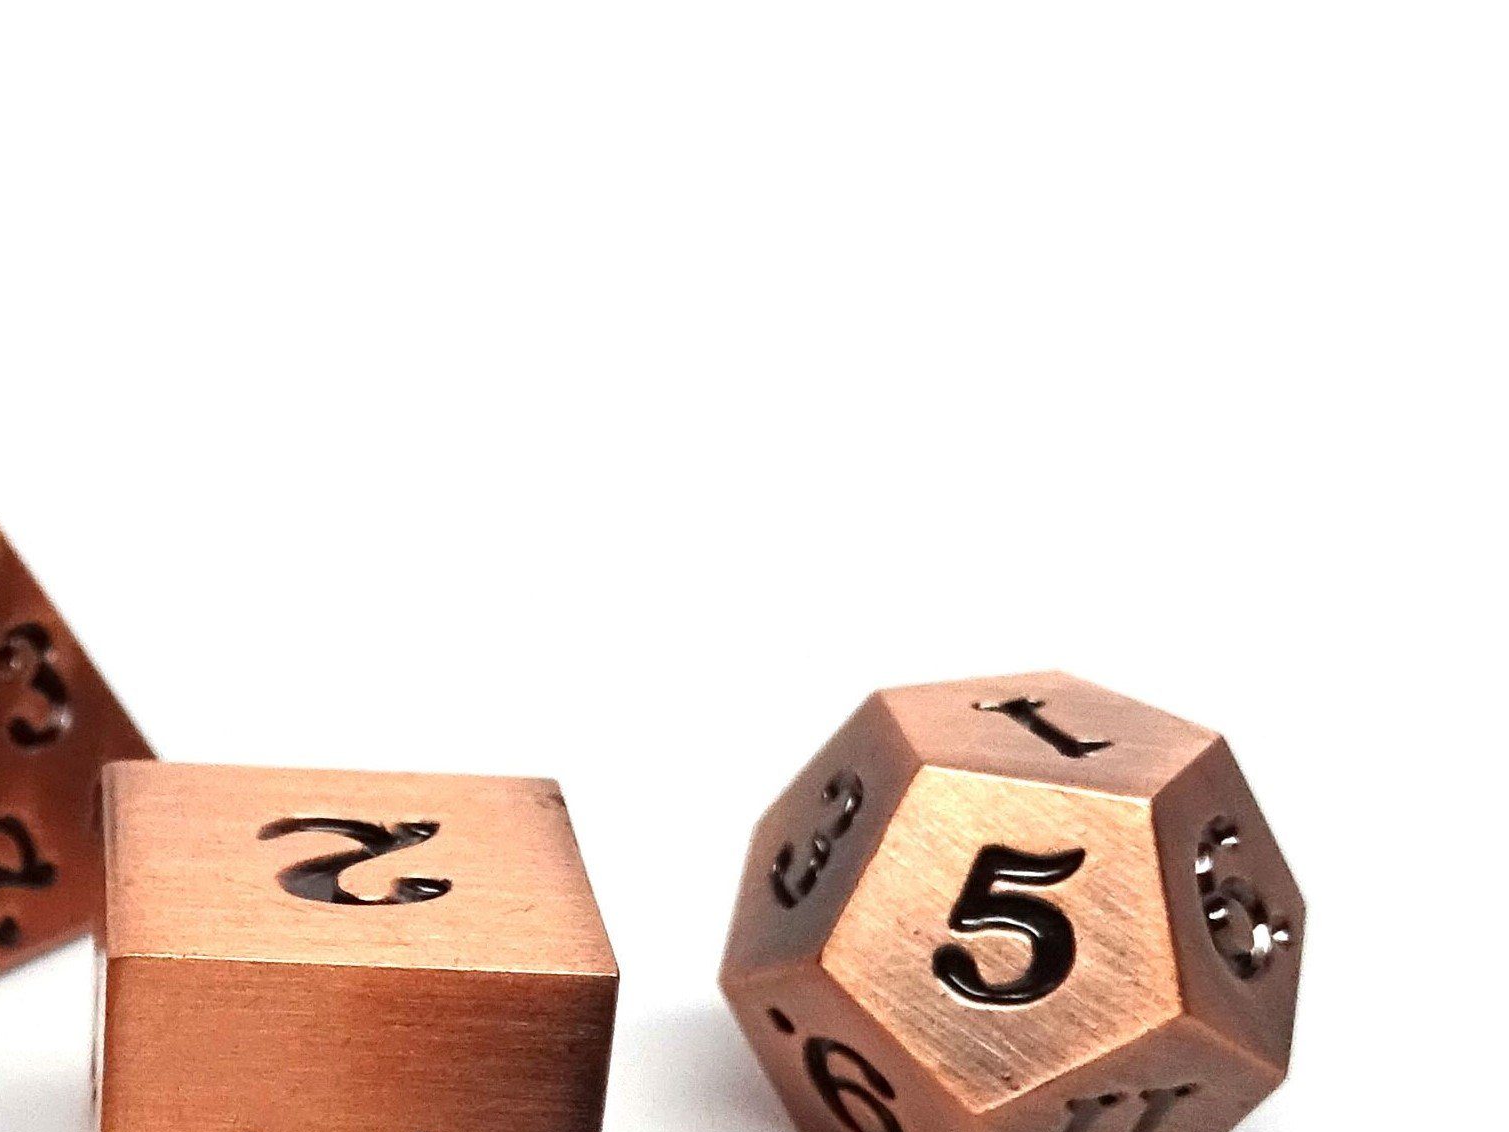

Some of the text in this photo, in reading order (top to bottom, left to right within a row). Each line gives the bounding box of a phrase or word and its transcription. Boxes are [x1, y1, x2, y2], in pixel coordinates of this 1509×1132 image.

[972, 697, 1114, 759] 1
[258, 817, 453, 906] 2
[771, 767, 864, 910] 3
[932, 843, 1087, 1009] 5
